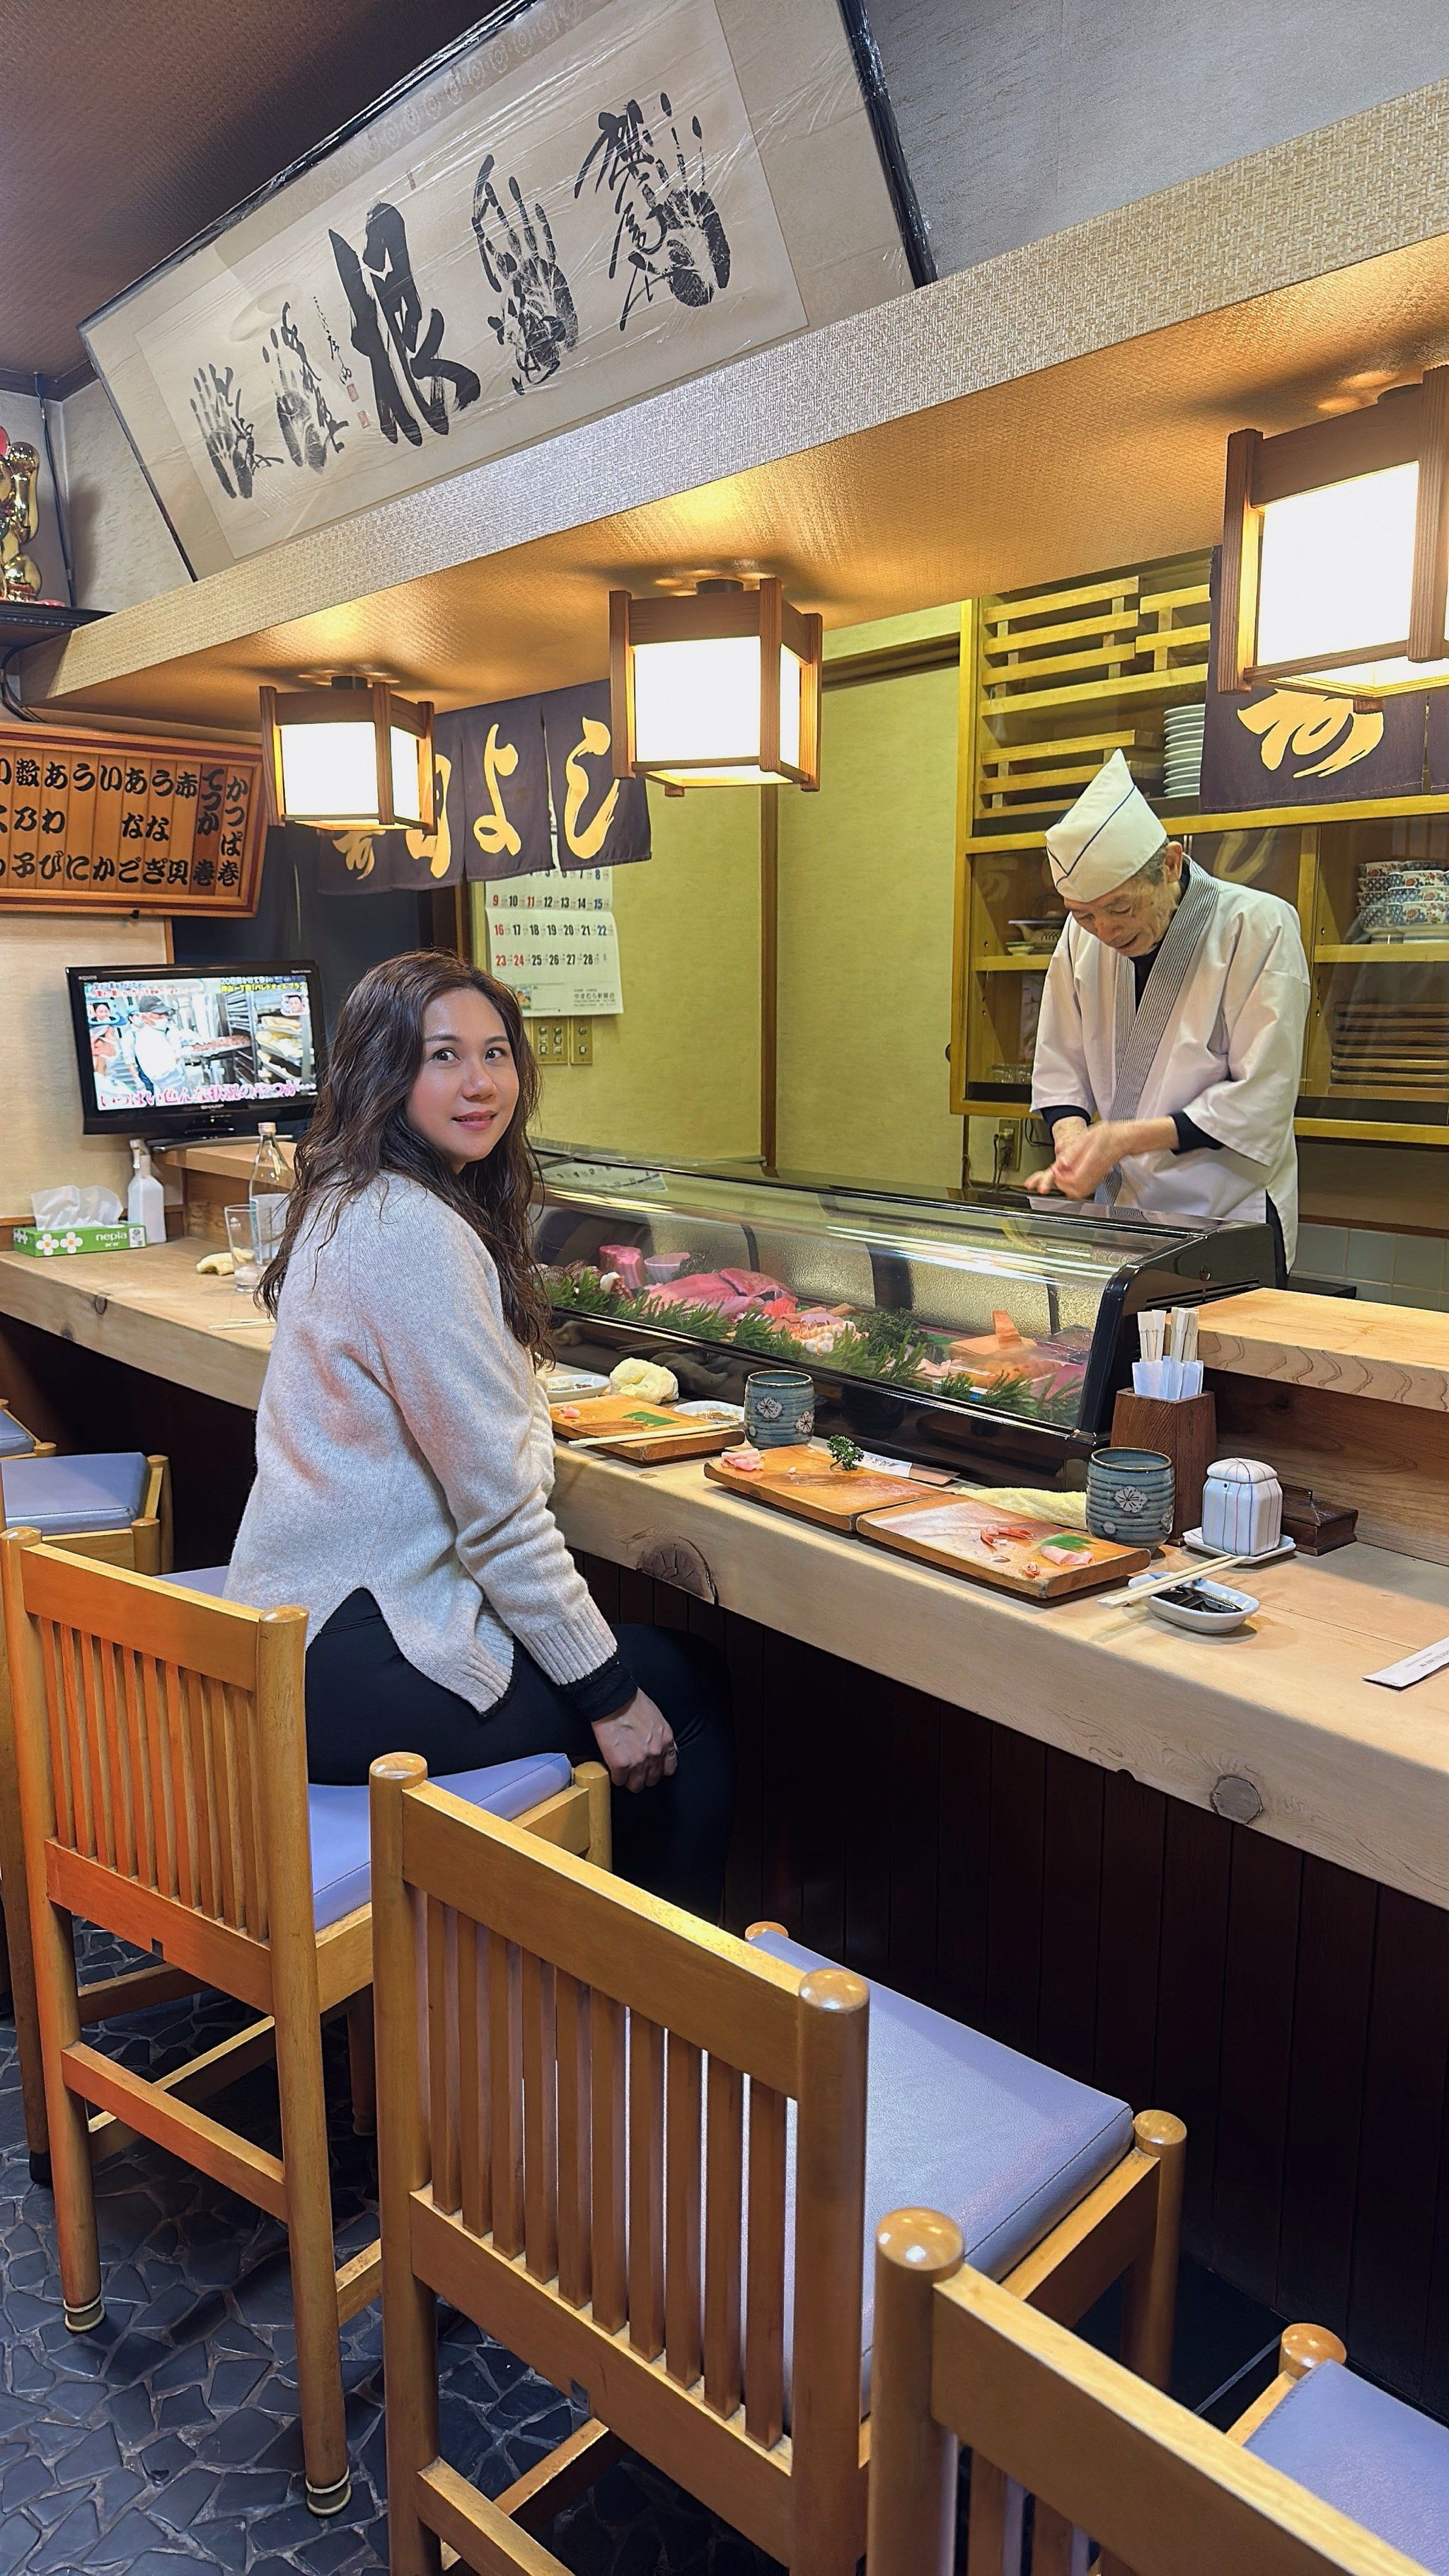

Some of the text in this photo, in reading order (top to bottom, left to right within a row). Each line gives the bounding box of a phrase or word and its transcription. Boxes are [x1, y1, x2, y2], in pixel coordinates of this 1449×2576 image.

[39, 761, 68, 880] あわび
[66, 763, 95, 880] うに
[93, 765, 122, 881] いか
[118, 767, 148, 883] あなご
[142, 769, 174, 885] うなぎ
[167, 771, 198, 885] 赤貝
[595, 868, 601, 880] 8
[492, 895, 603, 909] 9 10 11 12 13 14 15
[495, 924, 607, 936] 16 17 18 19 20 21 22
[496, 955, 507, 966] 23
[514, 955, 524, 966] 24
[532, 955, 542, 966] 25
[549, 955, 559, 965] 26
[567, 954, 575, 965] 27
[584, 954, 593, 965] 28
[96, 1231, 127, 1241] nepia
